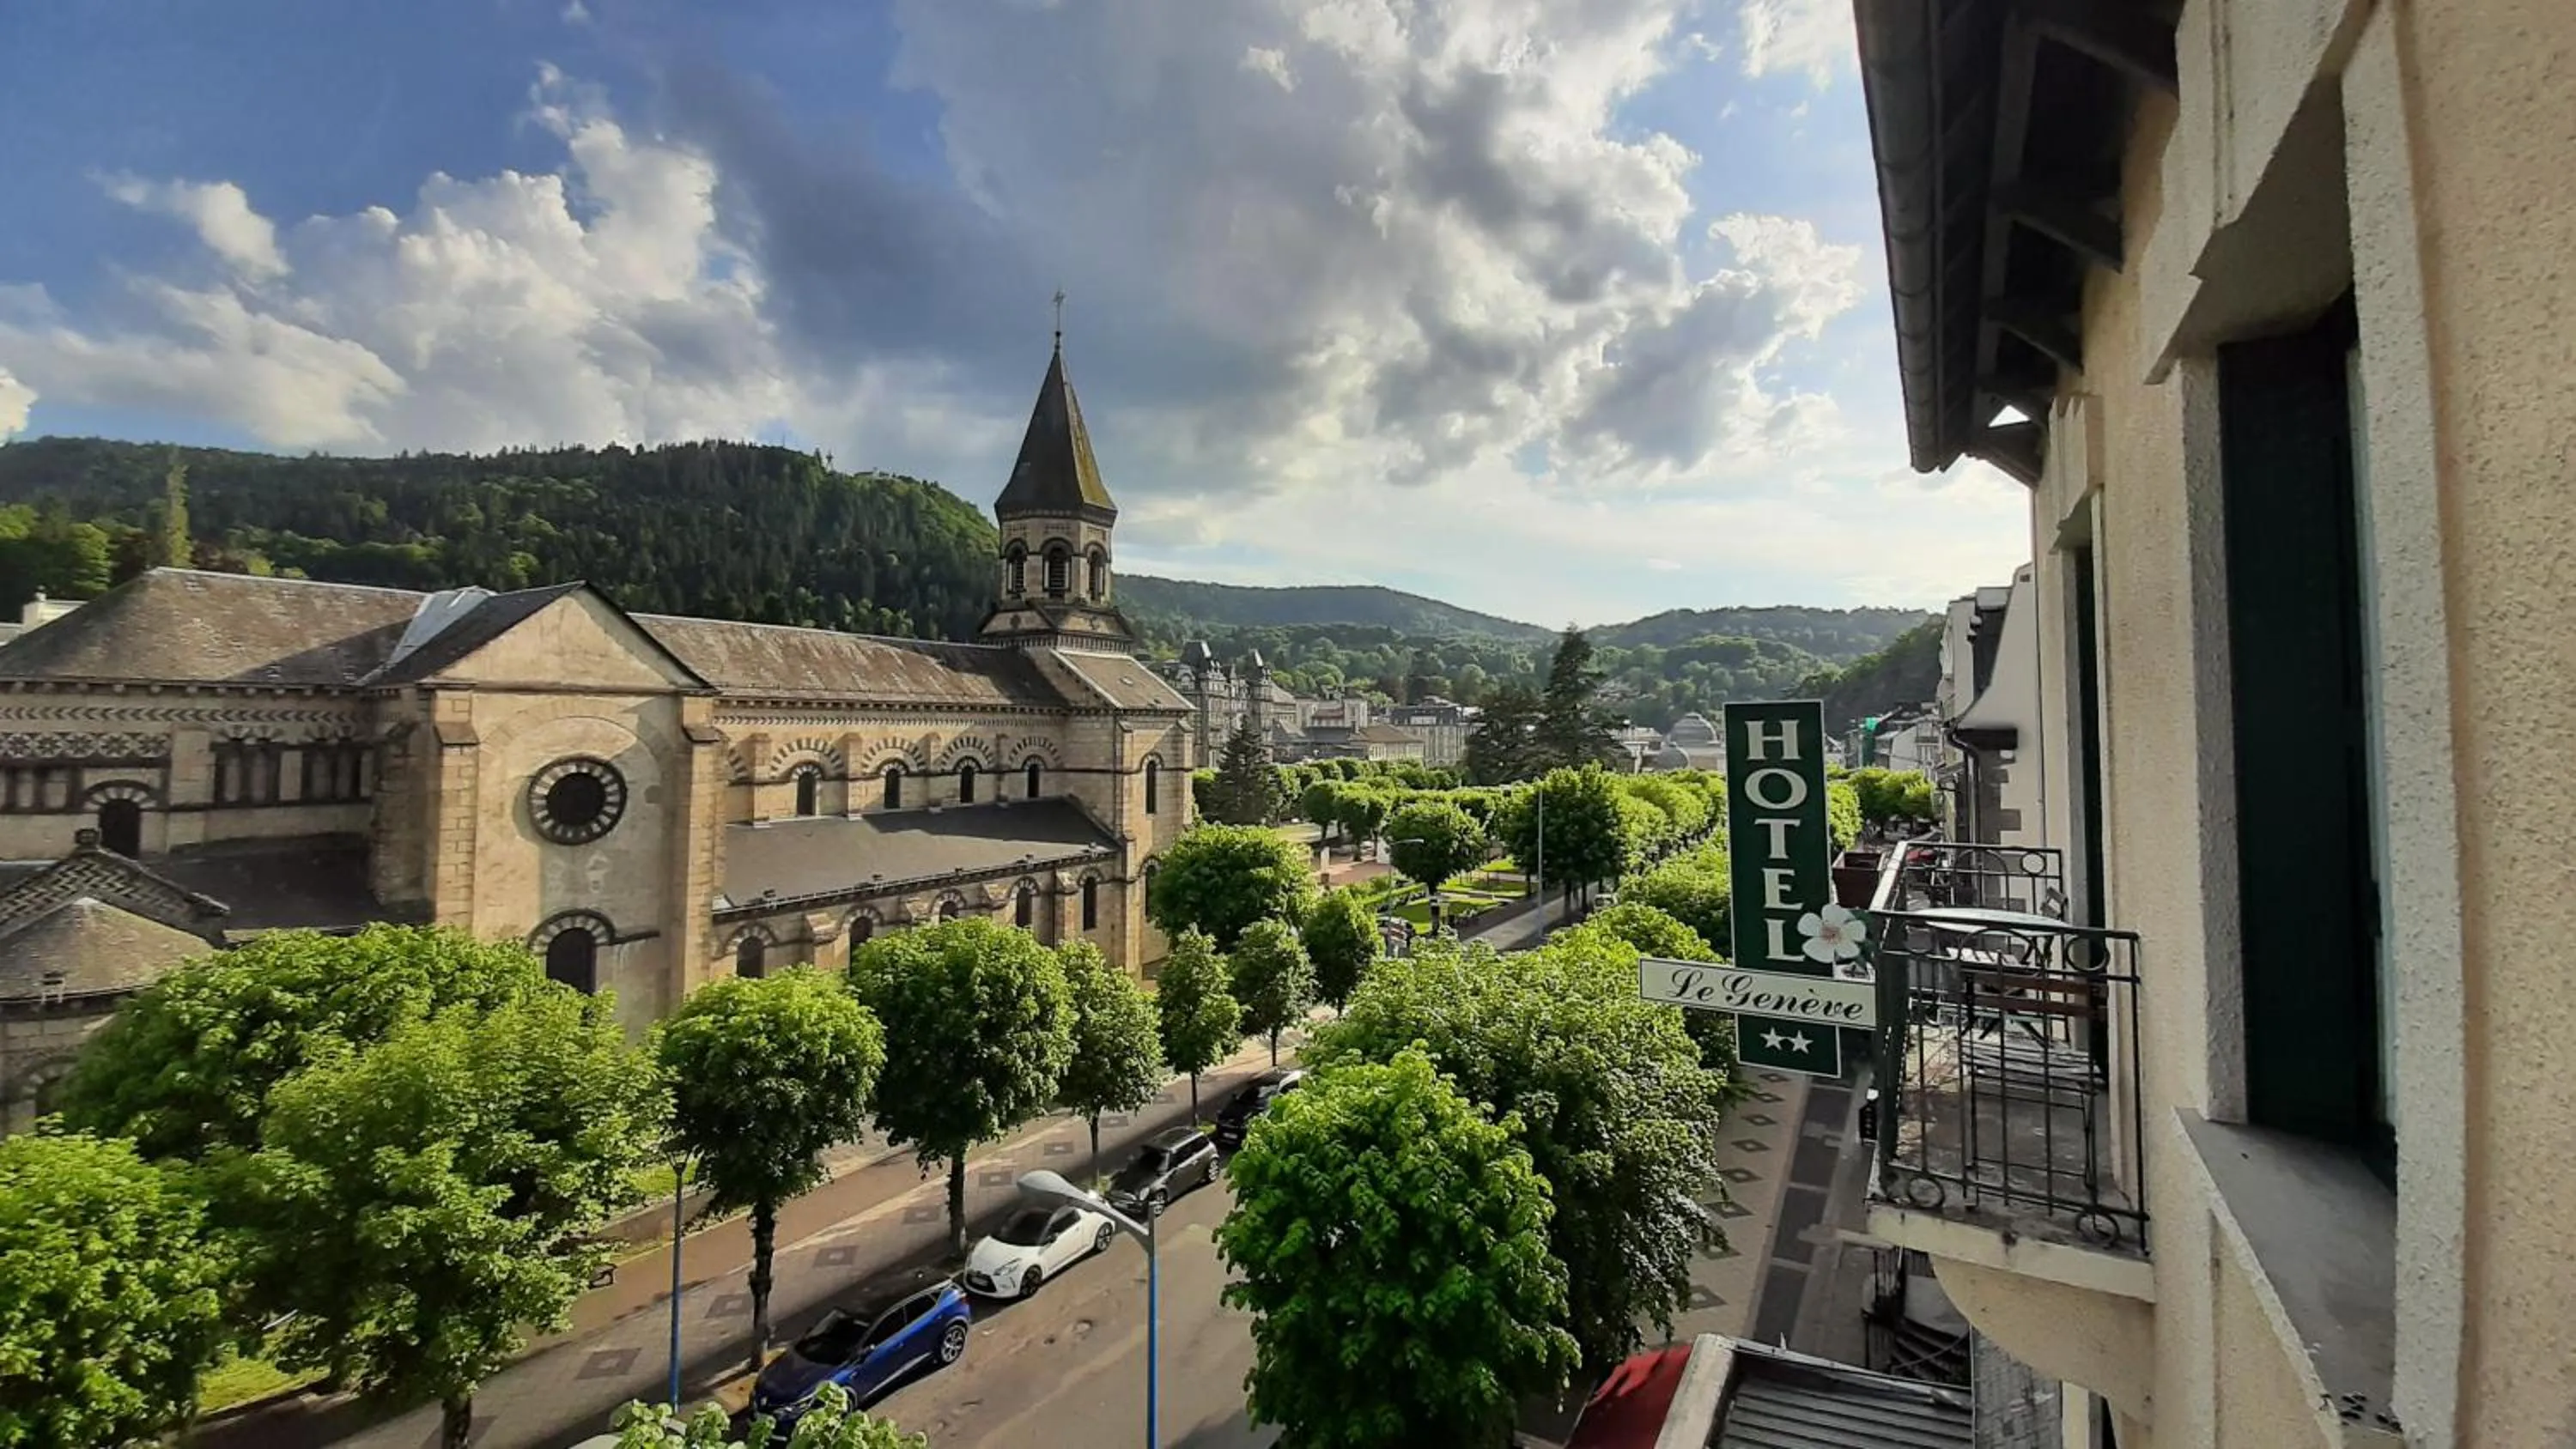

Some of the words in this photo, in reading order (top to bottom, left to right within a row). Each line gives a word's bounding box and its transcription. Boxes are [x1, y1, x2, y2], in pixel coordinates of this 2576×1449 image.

[1744, 719, 1807, 961] HOTEL
[1666, 968, 1715, 1002] Le
[1722, 974, 1864, 1020] Genève
